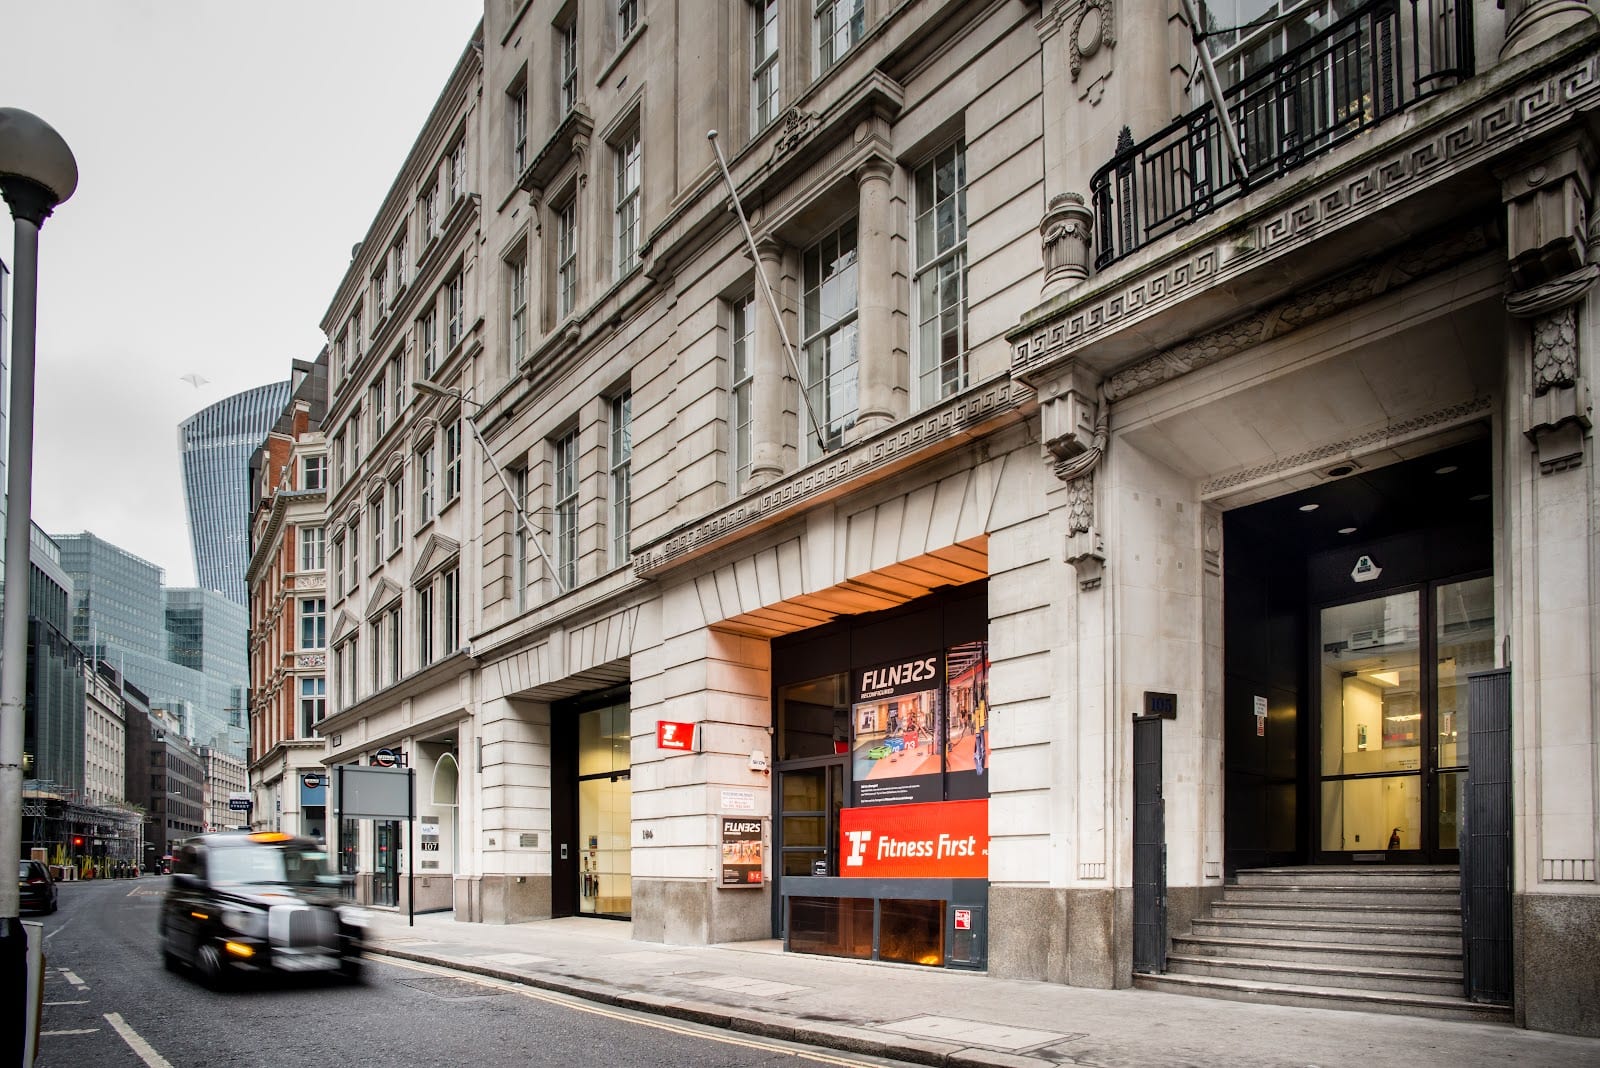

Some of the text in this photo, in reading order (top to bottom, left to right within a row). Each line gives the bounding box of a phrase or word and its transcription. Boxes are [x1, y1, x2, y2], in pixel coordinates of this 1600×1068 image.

[1151, 697, 1173, 712] 105
[424, 843, 437, 851] 107
[877, 836, 933, 860] Fitness
[937, 833, 976, 859] First
